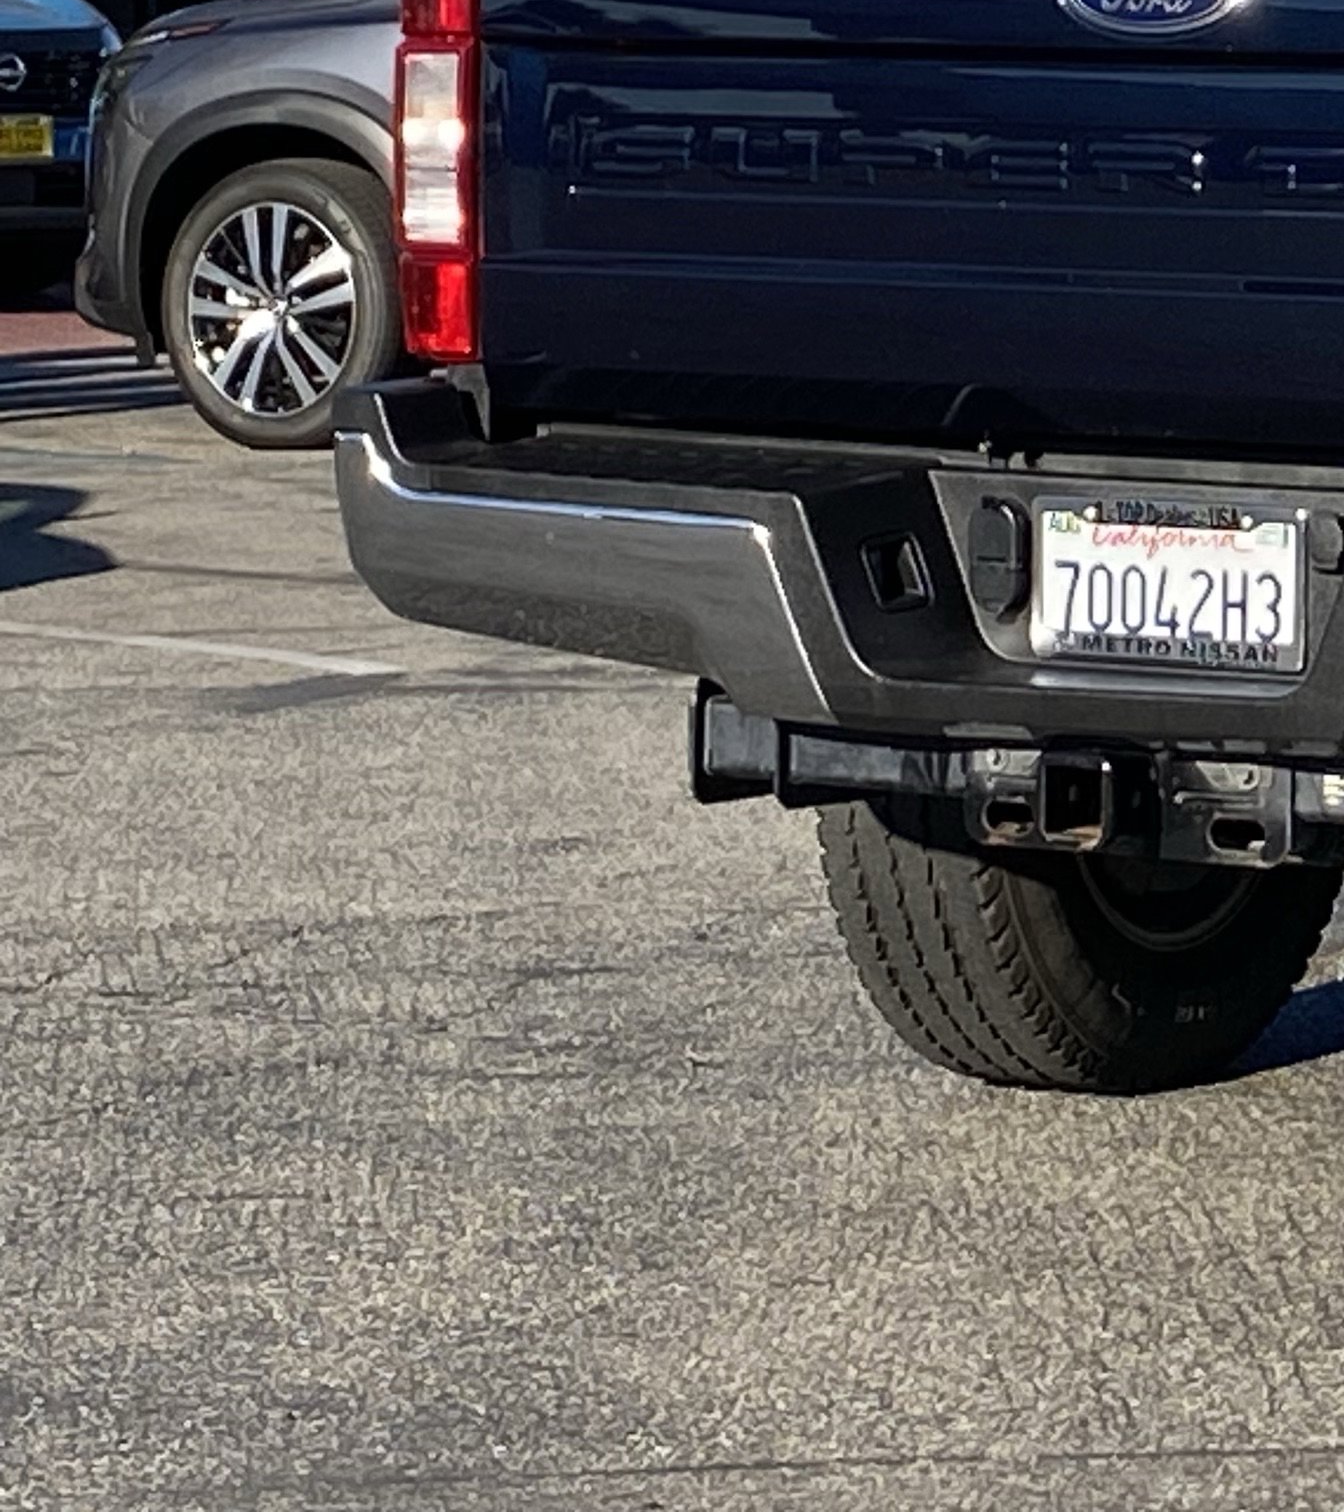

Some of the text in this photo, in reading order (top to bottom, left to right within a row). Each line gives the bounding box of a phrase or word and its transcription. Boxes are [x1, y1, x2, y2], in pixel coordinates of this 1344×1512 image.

[595, 124, 1206, 196] SUPER
[1091, 524, 1255, 560] California
[1054, 559, 1283, 644] 70042H3
[1082, 635, 1279, 663] METRO NISSAN
